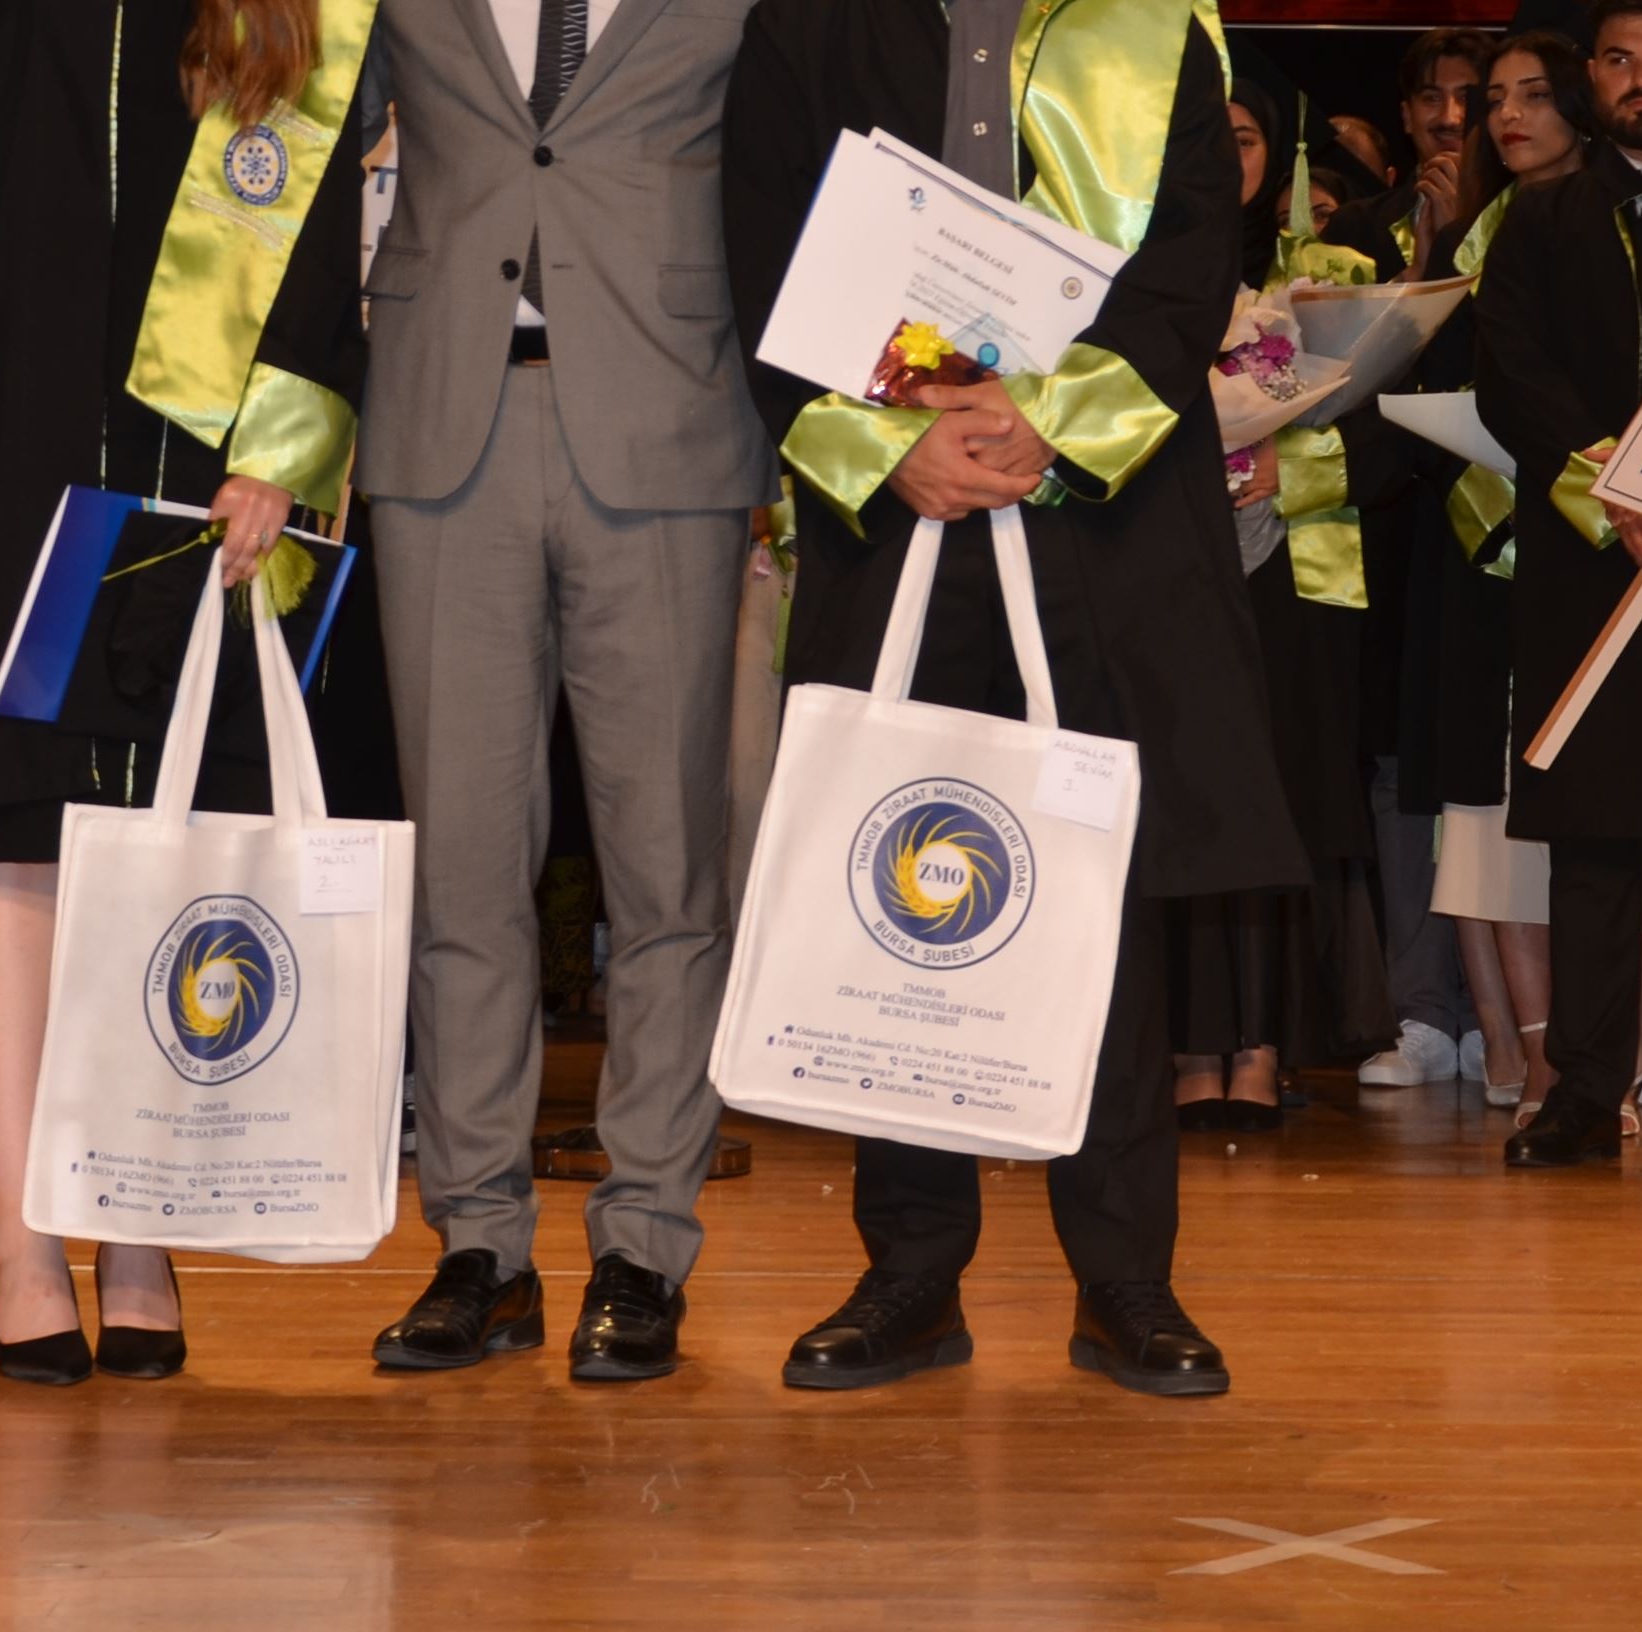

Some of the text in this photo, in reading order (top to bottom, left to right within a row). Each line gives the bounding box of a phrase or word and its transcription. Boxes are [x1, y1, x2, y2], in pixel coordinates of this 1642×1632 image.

[857, 783, 1028, 899] TMMOB ZİRAAT MÜHENDİSLERİ ODASI
[919, 862, 965, 887] ZMO
[873, 920, 976, 964] BURSA ŞUBESİ
[152, 944, 176, 994] TMMOB
[275, 953, 291, 998] ODASI
[836, 985, 879, 1002] ZİRAAT
[969, 1007, 1006, 1022] ODASI
[902, 983, 946, 999] TMMOB
[878, 1005, 918, 1021] BURSA
[168, 1041, 202, 1076] BURSA
[254, 1112, 290, 1122] ODASI
